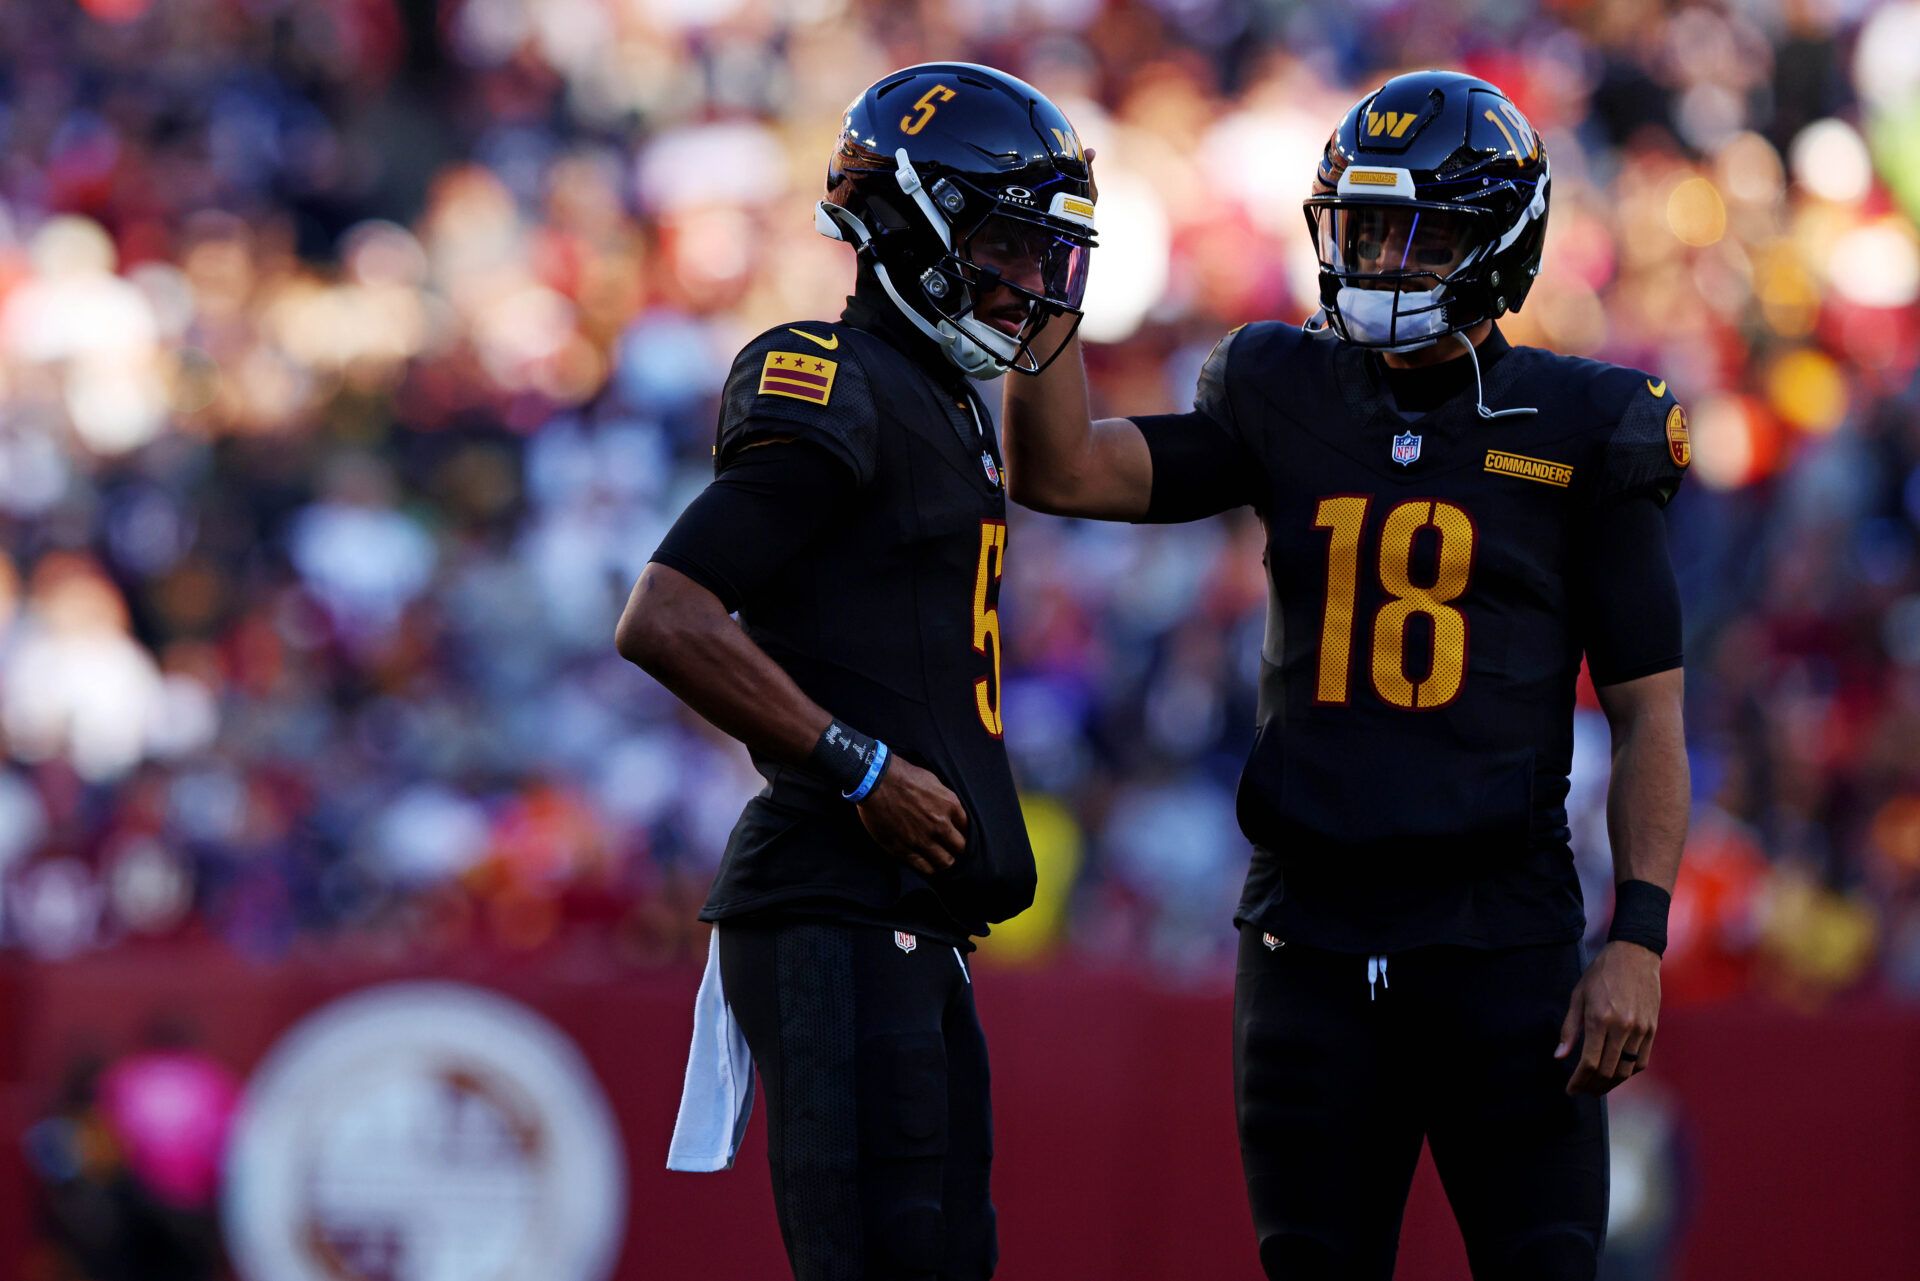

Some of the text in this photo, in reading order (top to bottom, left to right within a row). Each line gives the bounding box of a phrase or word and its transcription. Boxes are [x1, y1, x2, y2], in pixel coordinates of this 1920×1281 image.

[900, 84, 957, 135] 5
[1367, 111, 1418, 138] W
[1484, 104, 1538, 168] 18
[998, 193, 1036, 206] OAKLEY
[1396, 446, 1416, 460] NFL
[1485, 453, 1573, 484] COMMANDERS
[1312, 495, 1475, 709] 18
[973, 521, 1007, 737] 5
